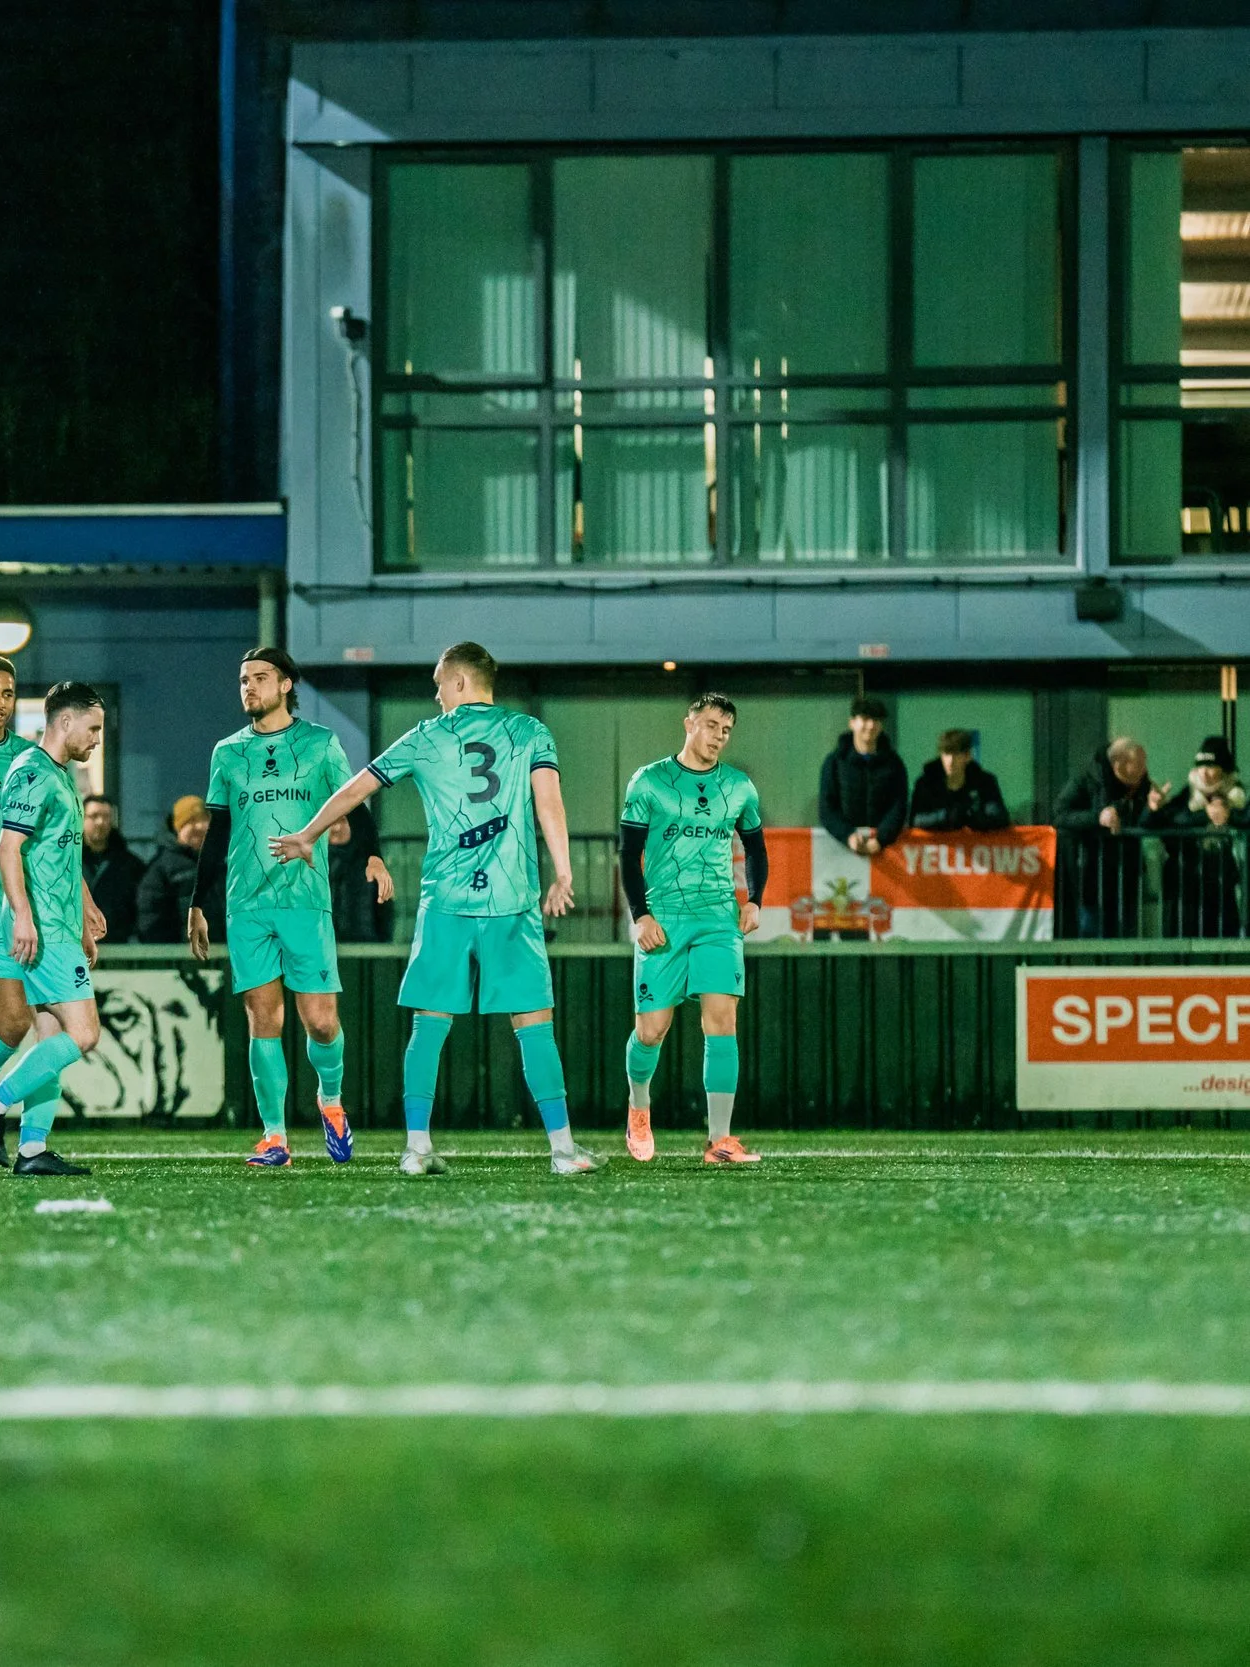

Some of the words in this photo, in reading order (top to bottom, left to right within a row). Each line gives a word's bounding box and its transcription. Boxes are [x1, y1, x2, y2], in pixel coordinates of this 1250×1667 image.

[463, 741, 501, 804] 3
[253, 787, 311, 803] GEMINI
[903, 843, 1040, 876] YELLOWS
